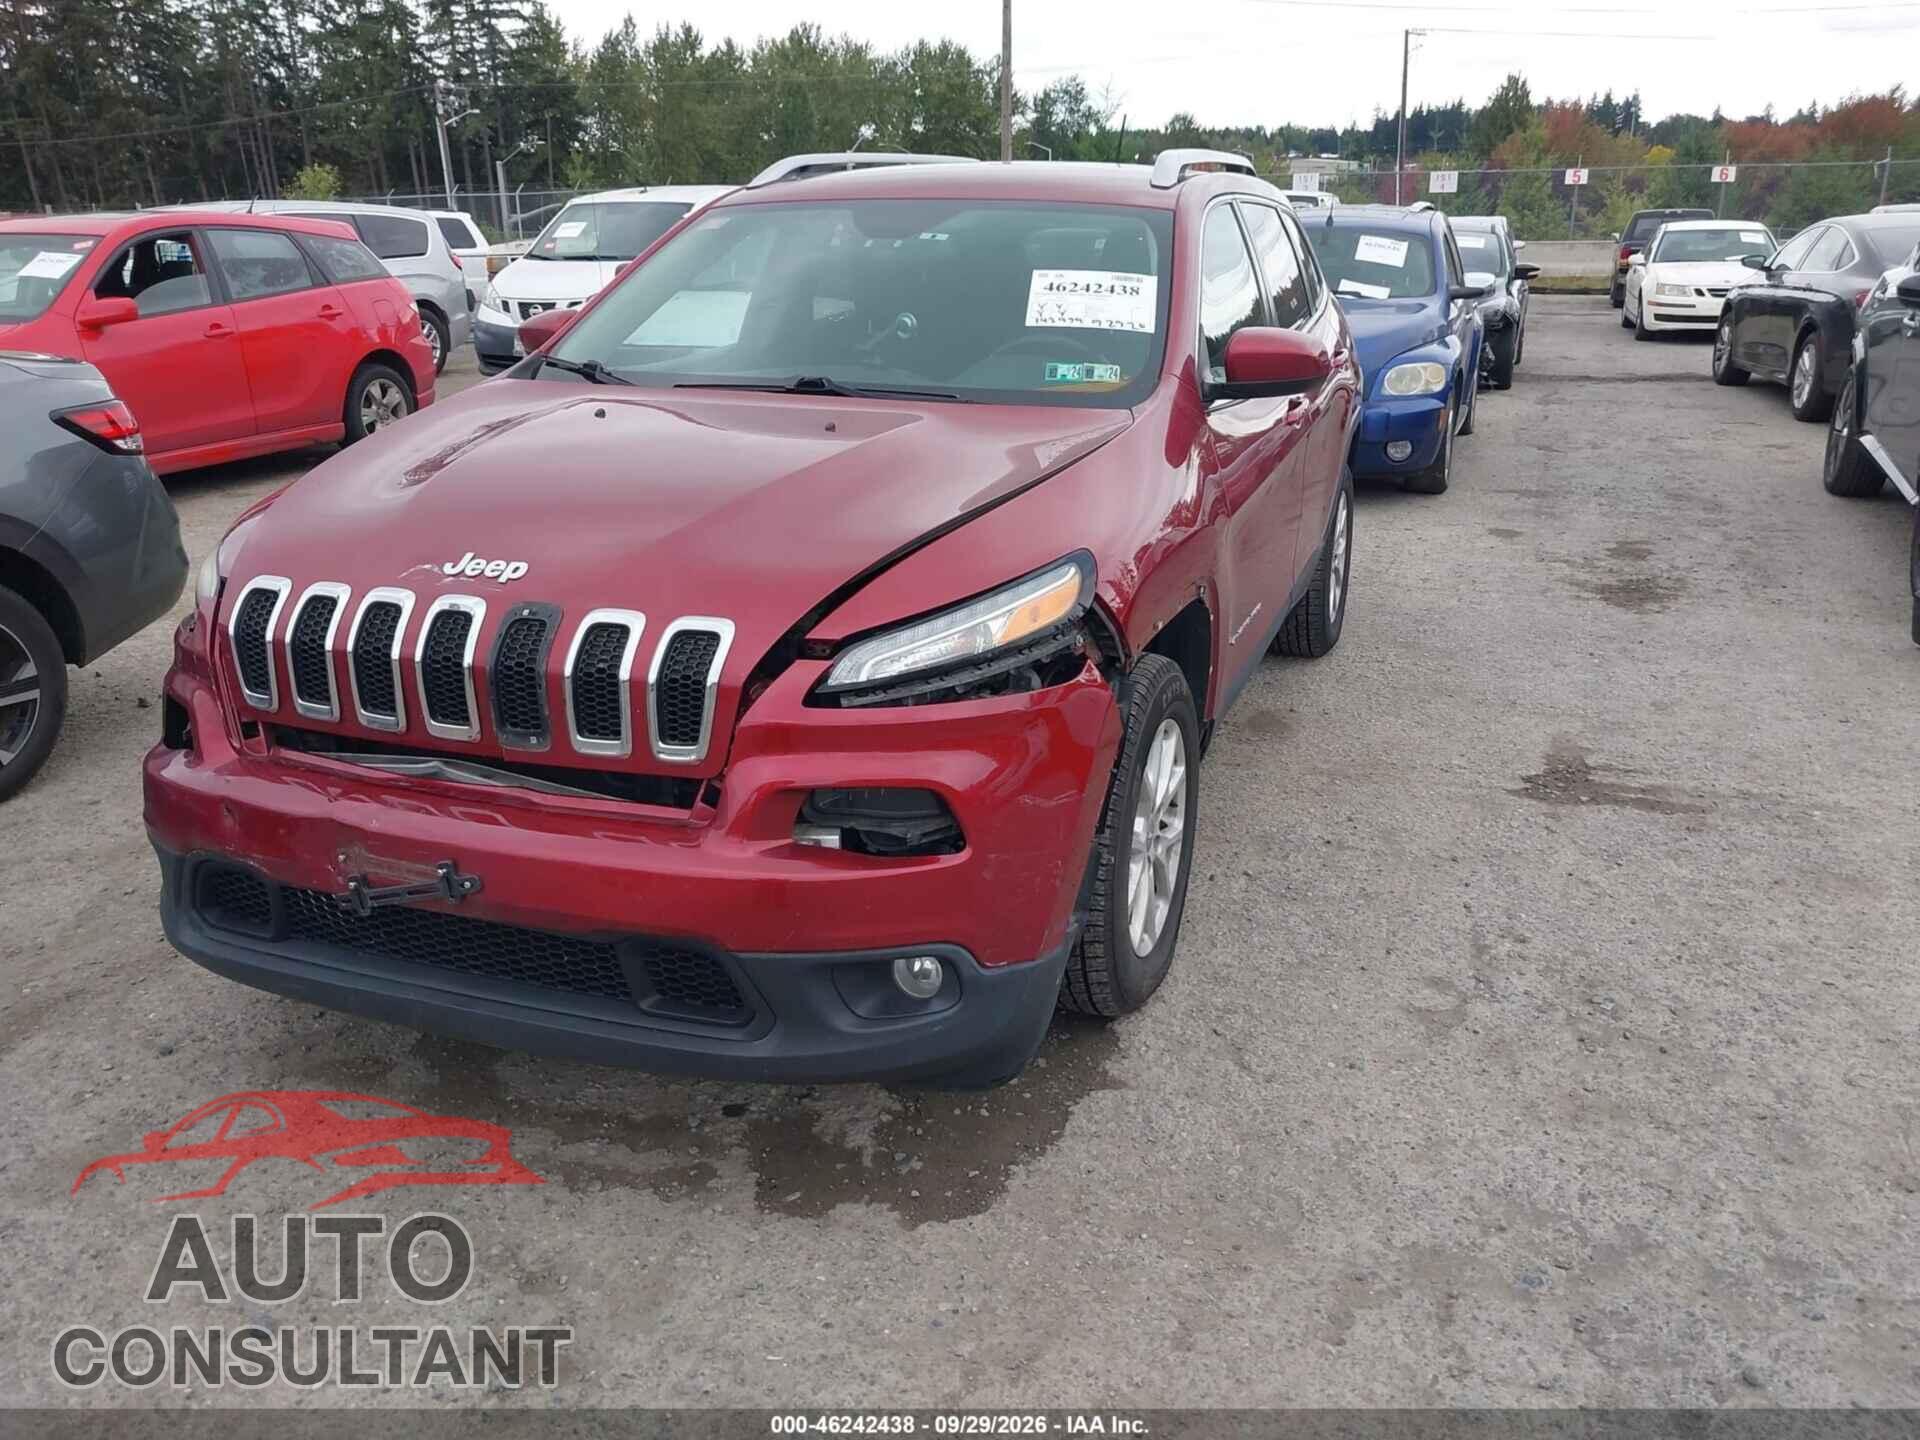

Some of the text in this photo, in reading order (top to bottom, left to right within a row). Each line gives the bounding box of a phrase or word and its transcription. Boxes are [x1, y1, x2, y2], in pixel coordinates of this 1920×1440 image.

[1571, 170, 1582, 184] 5
[1718, 167, 1730, 182] 6
[1043, 282, 1140, 296] 46242438
[1071, 366, 1082, 378] 24
[1108, 367, 1119, 379] 24
[443, 552, 528, 583] Jeep
